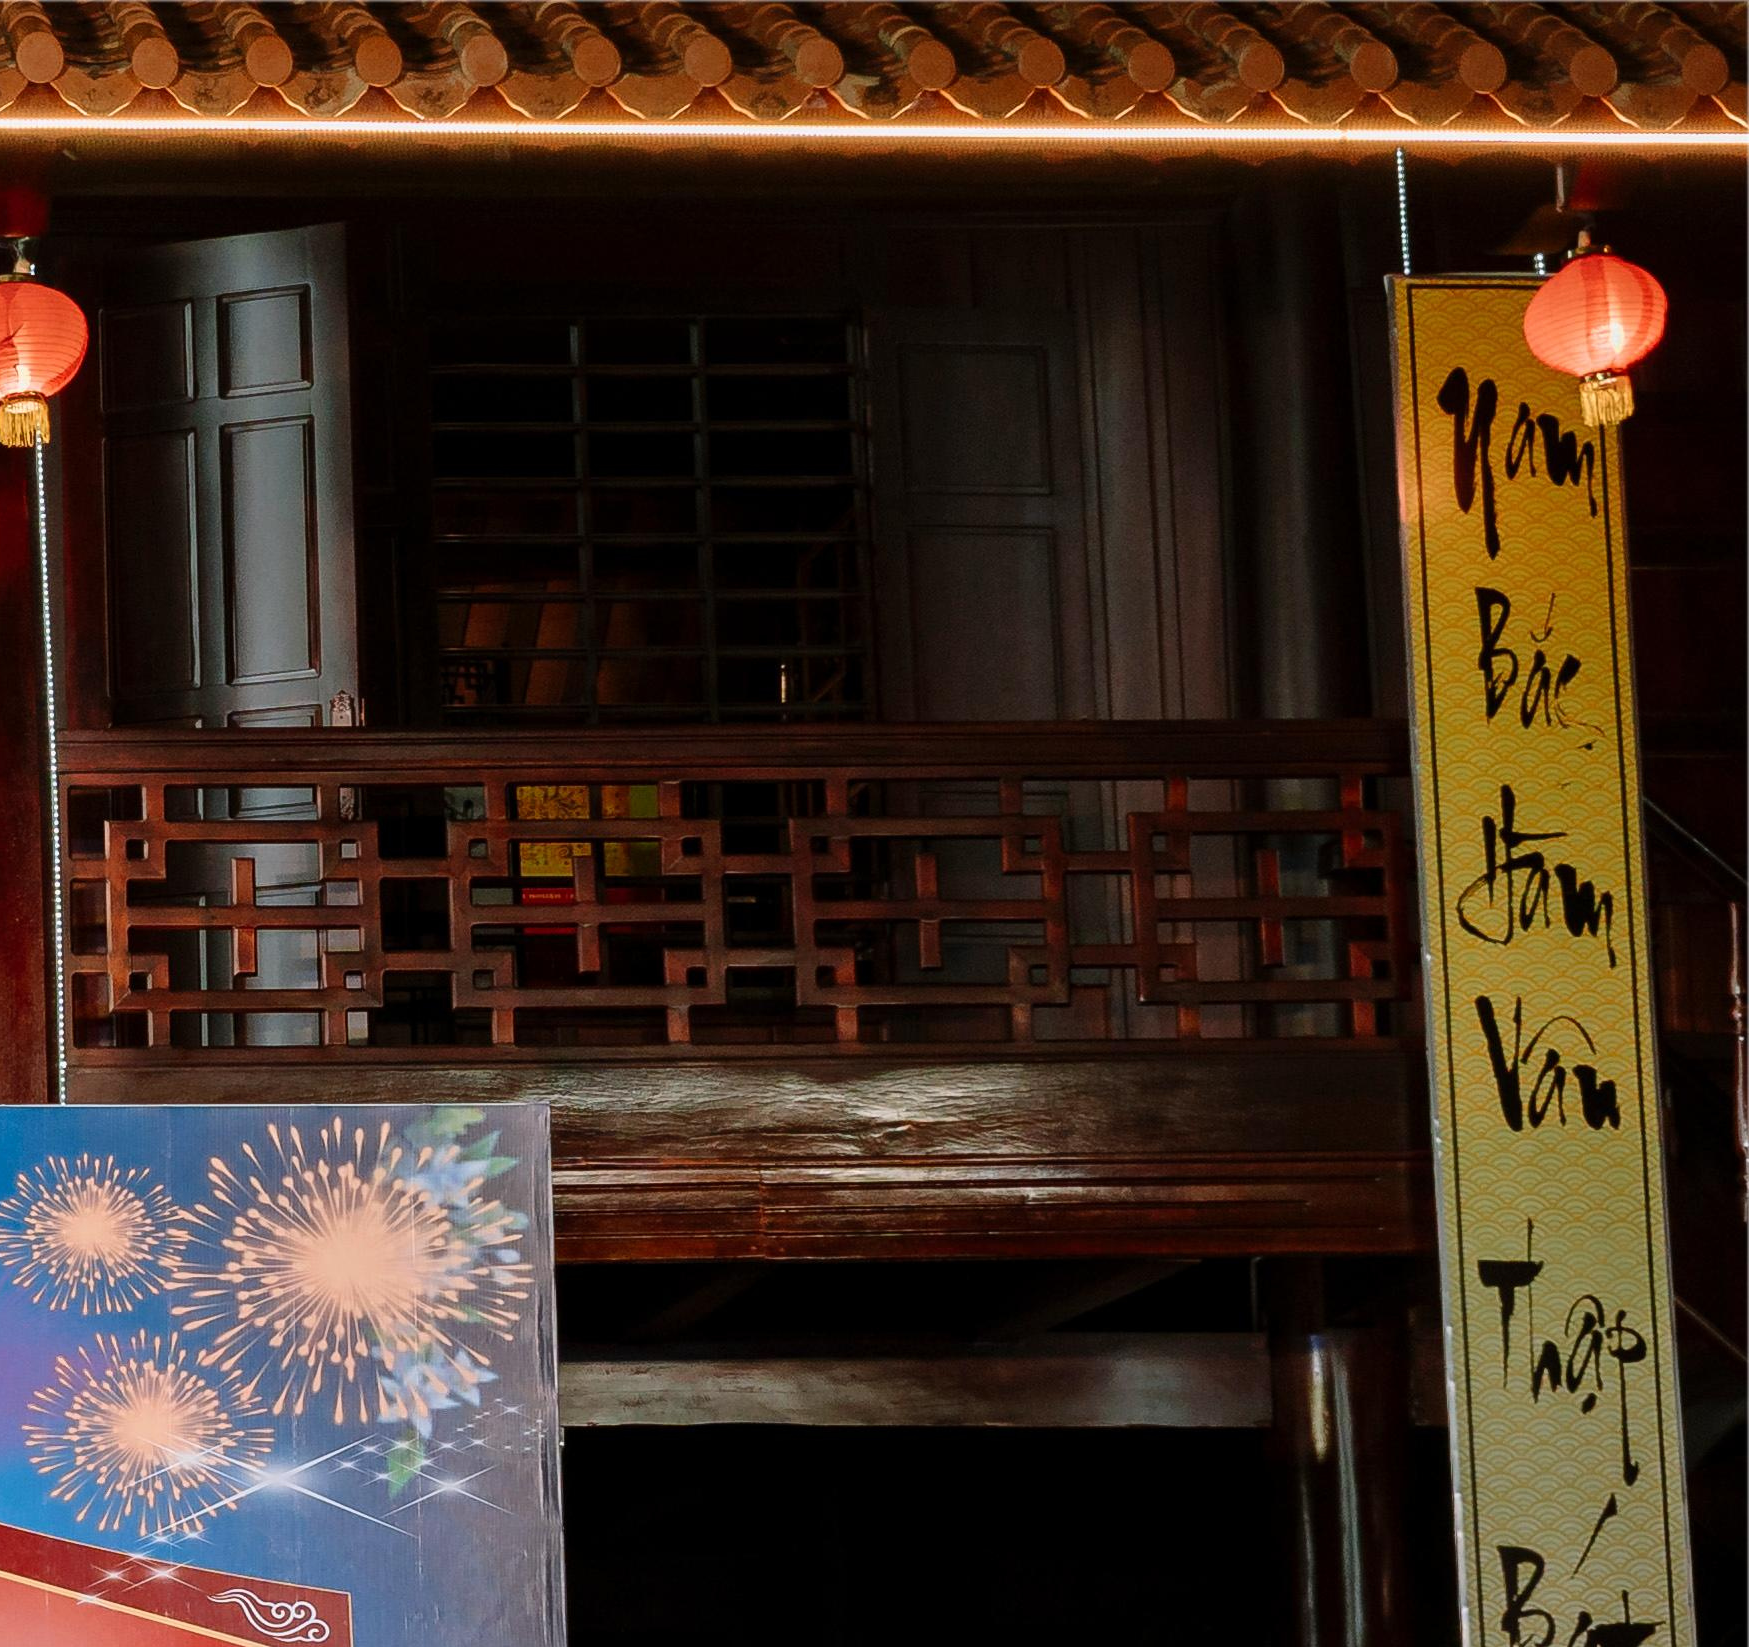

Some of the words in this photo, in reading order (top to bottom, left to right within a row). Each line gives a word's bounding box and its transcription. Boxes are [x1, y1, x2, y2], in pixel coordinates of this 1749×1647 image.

[1437, 367, 1598, 560] Nam
[1457, 784, 1617, 968] Hàm
[1478, 1217, 1647, 1487] Thập
